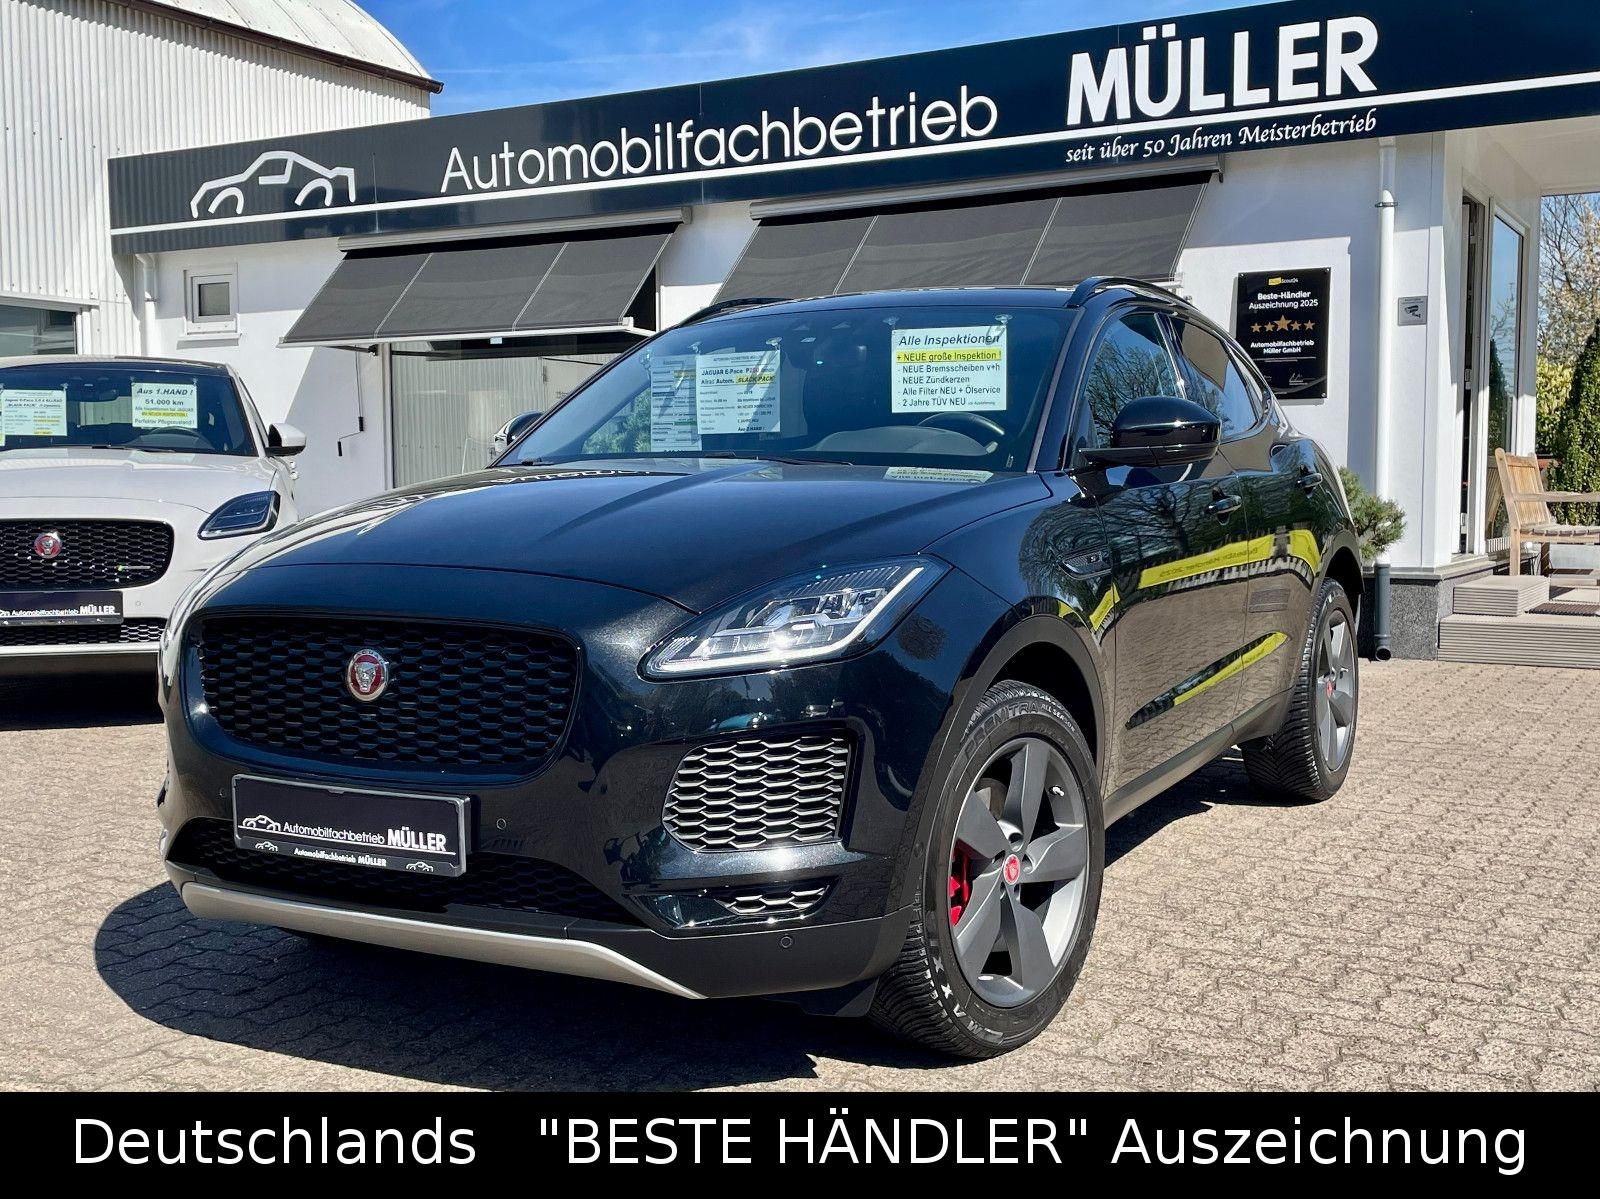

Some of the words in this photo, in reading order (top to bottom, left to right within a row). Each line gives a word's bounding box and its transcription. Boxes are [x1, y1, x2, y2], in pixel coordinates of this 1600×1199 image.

[440, 85, 998, 194] Automobilfachbetrieb
[1066, 16, 1378, 126] MÜLLER
[1066, 144, 1094, 163] seit
[1099, 136, 1138, 159] über
[1143, 141, 1164, 158] 50
[1168, 127, 1233, 156] Jahren
[1238, 108, 1377, 145] Meisterbetrieb
[1257, 290, 1311, 301] Beste-Händler
[1248, 301, 1299, 310] Auszeichnung
[1300, 299, 1319, 307] 2025
[899, 335, 920, 346] Alle
[924, 334, 1000, 347] Inspektionen
[1250, 339, 1315, 348] Automobilfachbetrieb
[904, 353, 926, 361] NEUE
[928, 352, 952, 363] große
[954, 351, 997, 362] Inspektion
[902, 365, 924, 373] NEUE
[926, 363, 984, 373] Bremsscheiben
[986, 363, 1001, 371] v+h
[902, 376, 924, 384] NEUE
[925, 375, 970, 384] Zündkerzen
[902, 387, 917, 396] Alle
[919, 386, 938, 395] Filter
[939, 387, 957, 395] NEU
[965, 385, 1001, 395] Ölservice
[902, 398, 908, 407] 2
[909, 398, 930, 407] Jahre
[932, 397, 948, 406] TÜV
[949, 397, 966, 406] NEU
[80, 604, 115, 614] MÜLLER
[283, 821, 385, 844] Automobilfachbetrieb
[387, 826, 447, 851] MÜLLER
[294, 848, 356, 864] Automobilfachbetrieb
[357, 854, 387, 867] MÜLLER
